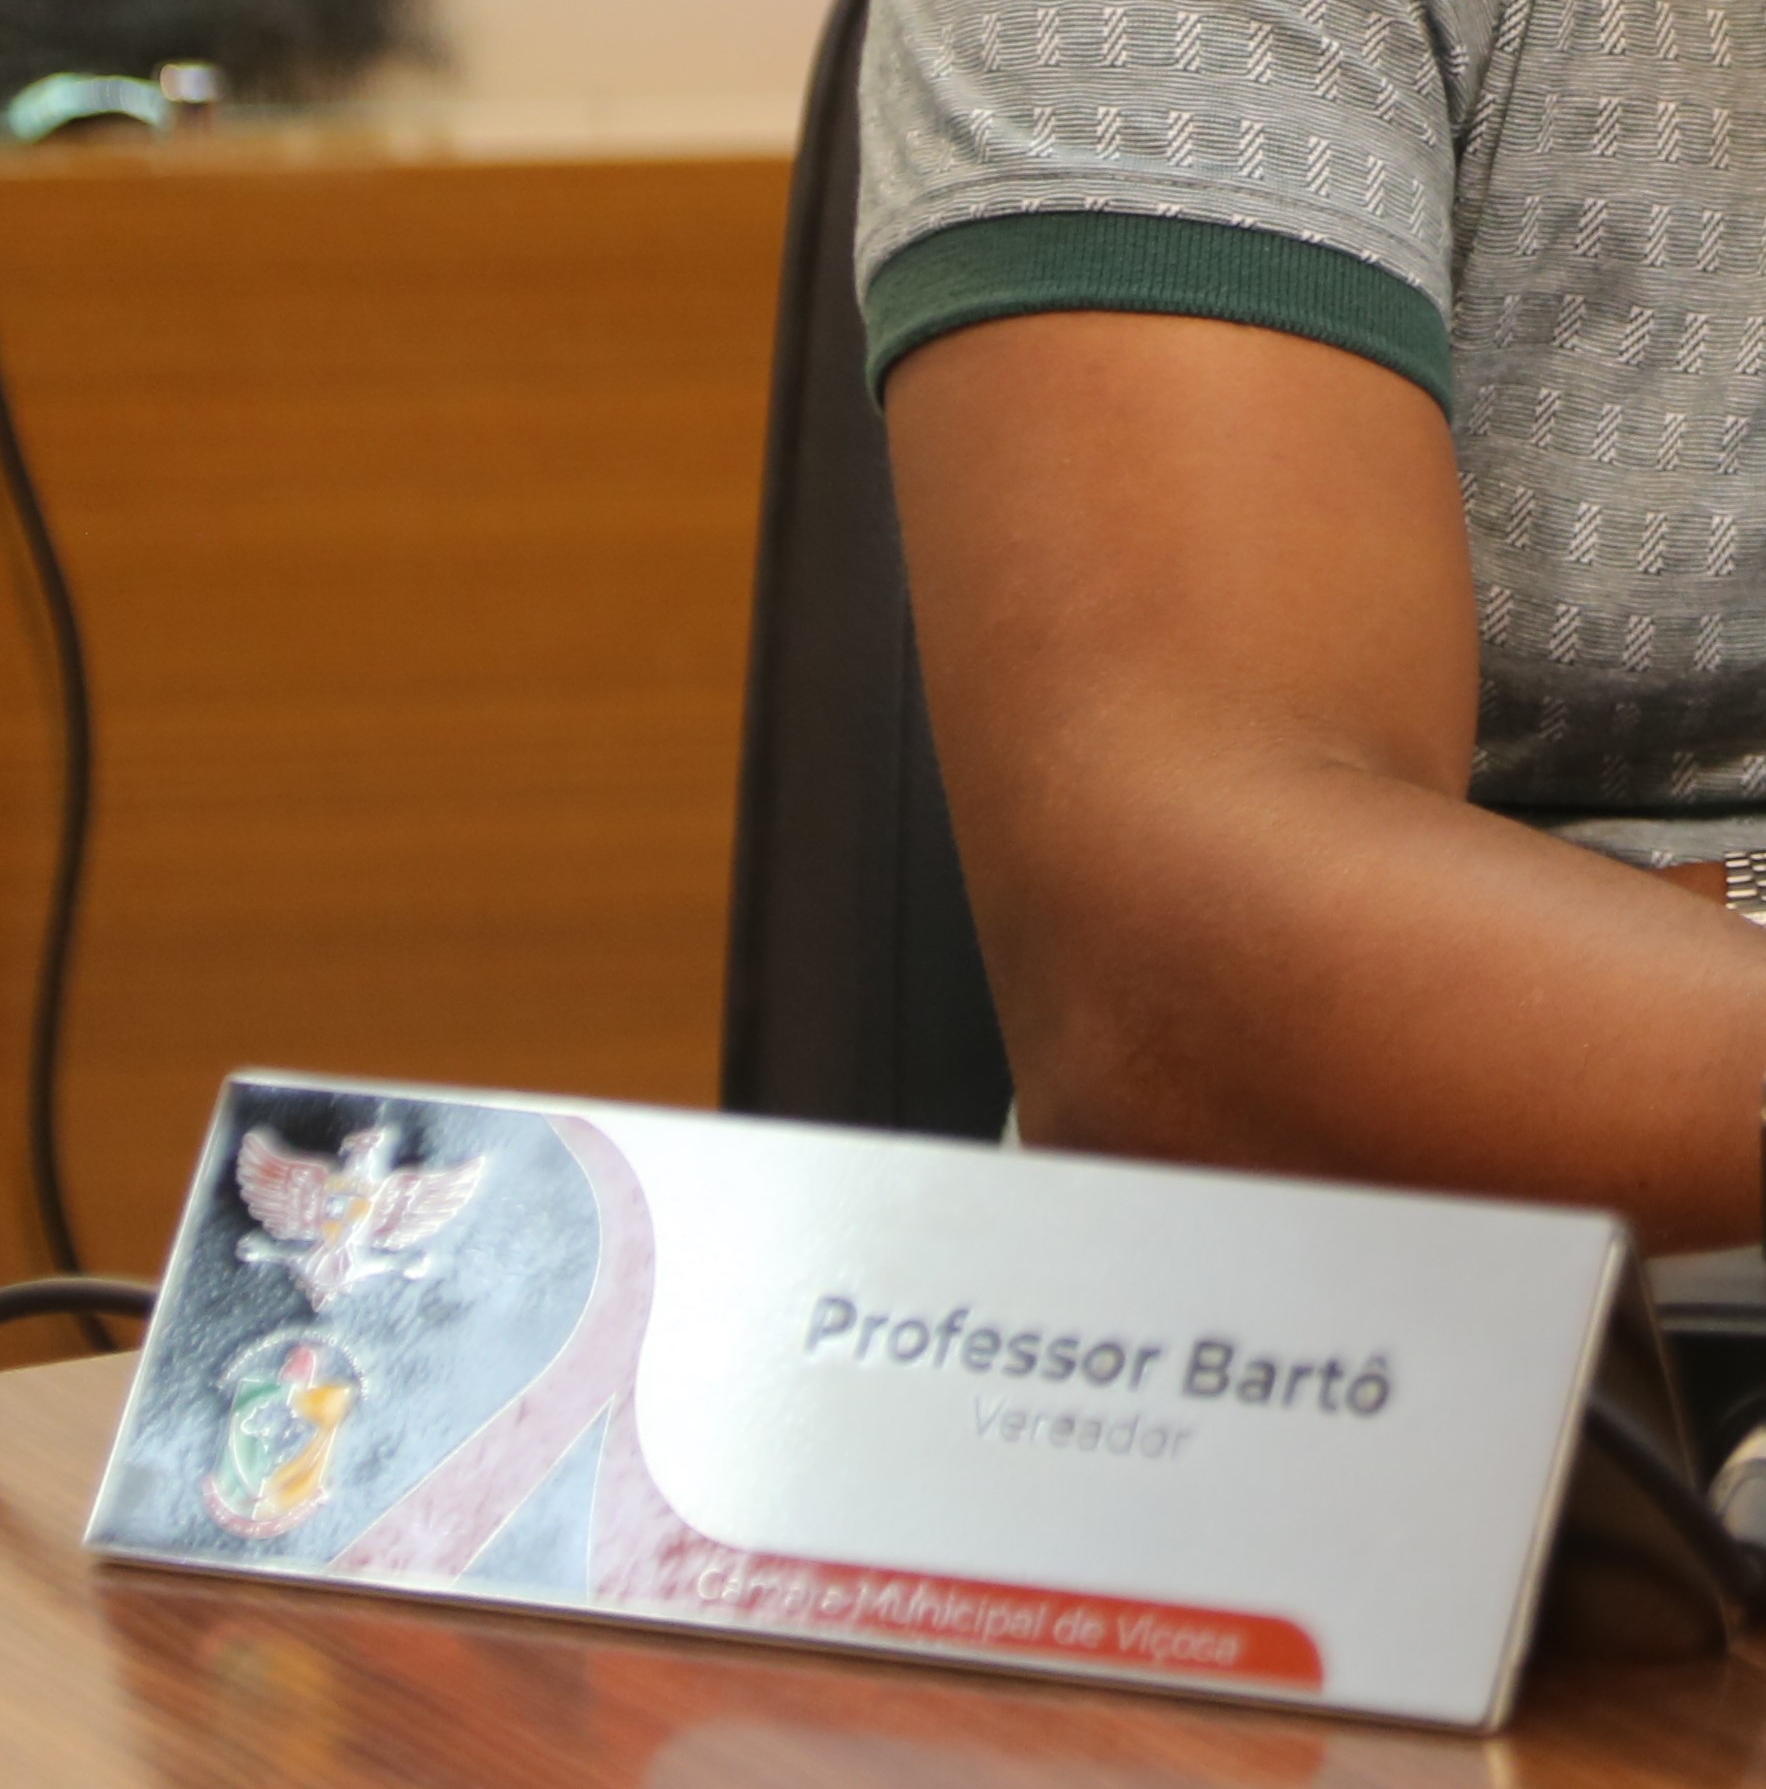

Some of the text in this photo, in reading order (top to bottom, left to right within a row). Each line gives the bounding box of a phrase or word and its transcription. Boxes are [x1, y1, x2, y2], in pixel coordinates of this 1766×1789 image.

[802, 1295, 1392, 1418] Professor Bartô
[973, 1393, 1194, 1459] Vereador
[854, 1578, 1047, 1644] Municipal
[1053, 1609, 1104, 1649] de
